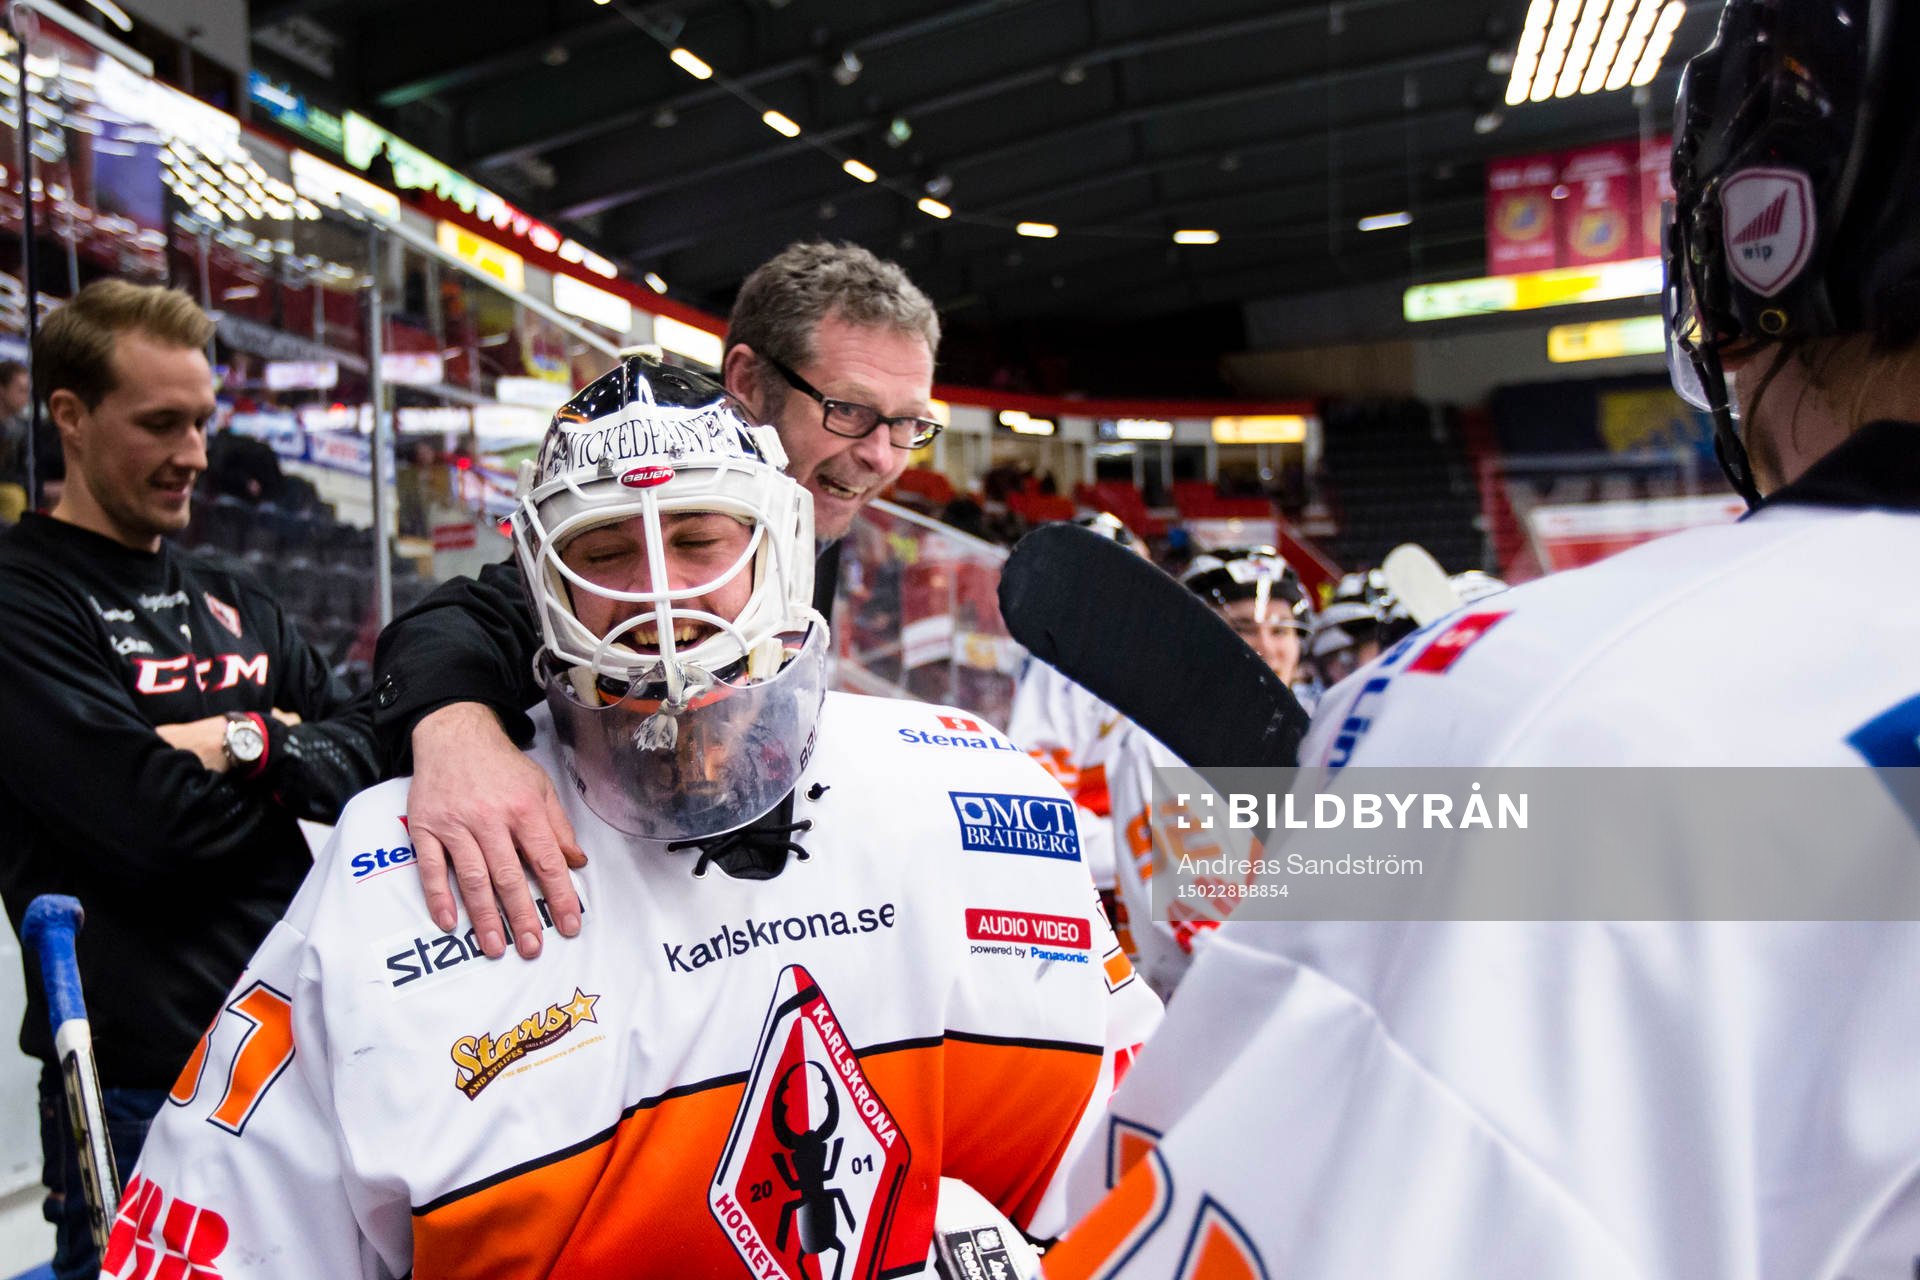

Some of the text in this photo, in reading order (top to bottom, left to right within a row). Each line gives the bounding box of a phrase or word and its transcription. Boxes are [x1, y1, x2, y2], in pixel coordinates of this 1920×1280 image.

[623, 469, 674, 484] BAUER
[898, 729, 988, 750] Stena
[984, 797, 1072, 836] MCT
[351, 842, 418, 877] Ste
[966, 826, 1077, 855] BRATTBERG
[978, 915, 1080, 942] AUDIO VIDEO
[970, 945, 1089, 964] powered by Panasonic
[169, 979, 297, 1138] 7
[451, 1003, 570, 1089] Stars
[468, 1047, 525, 1096] AND STRIPES
[812, 1003, 899, 1149] KARLSKRONA
[751, 1154, 873, 1203] 20 01
[715, 1194, 790, 1280] HOCKEY
